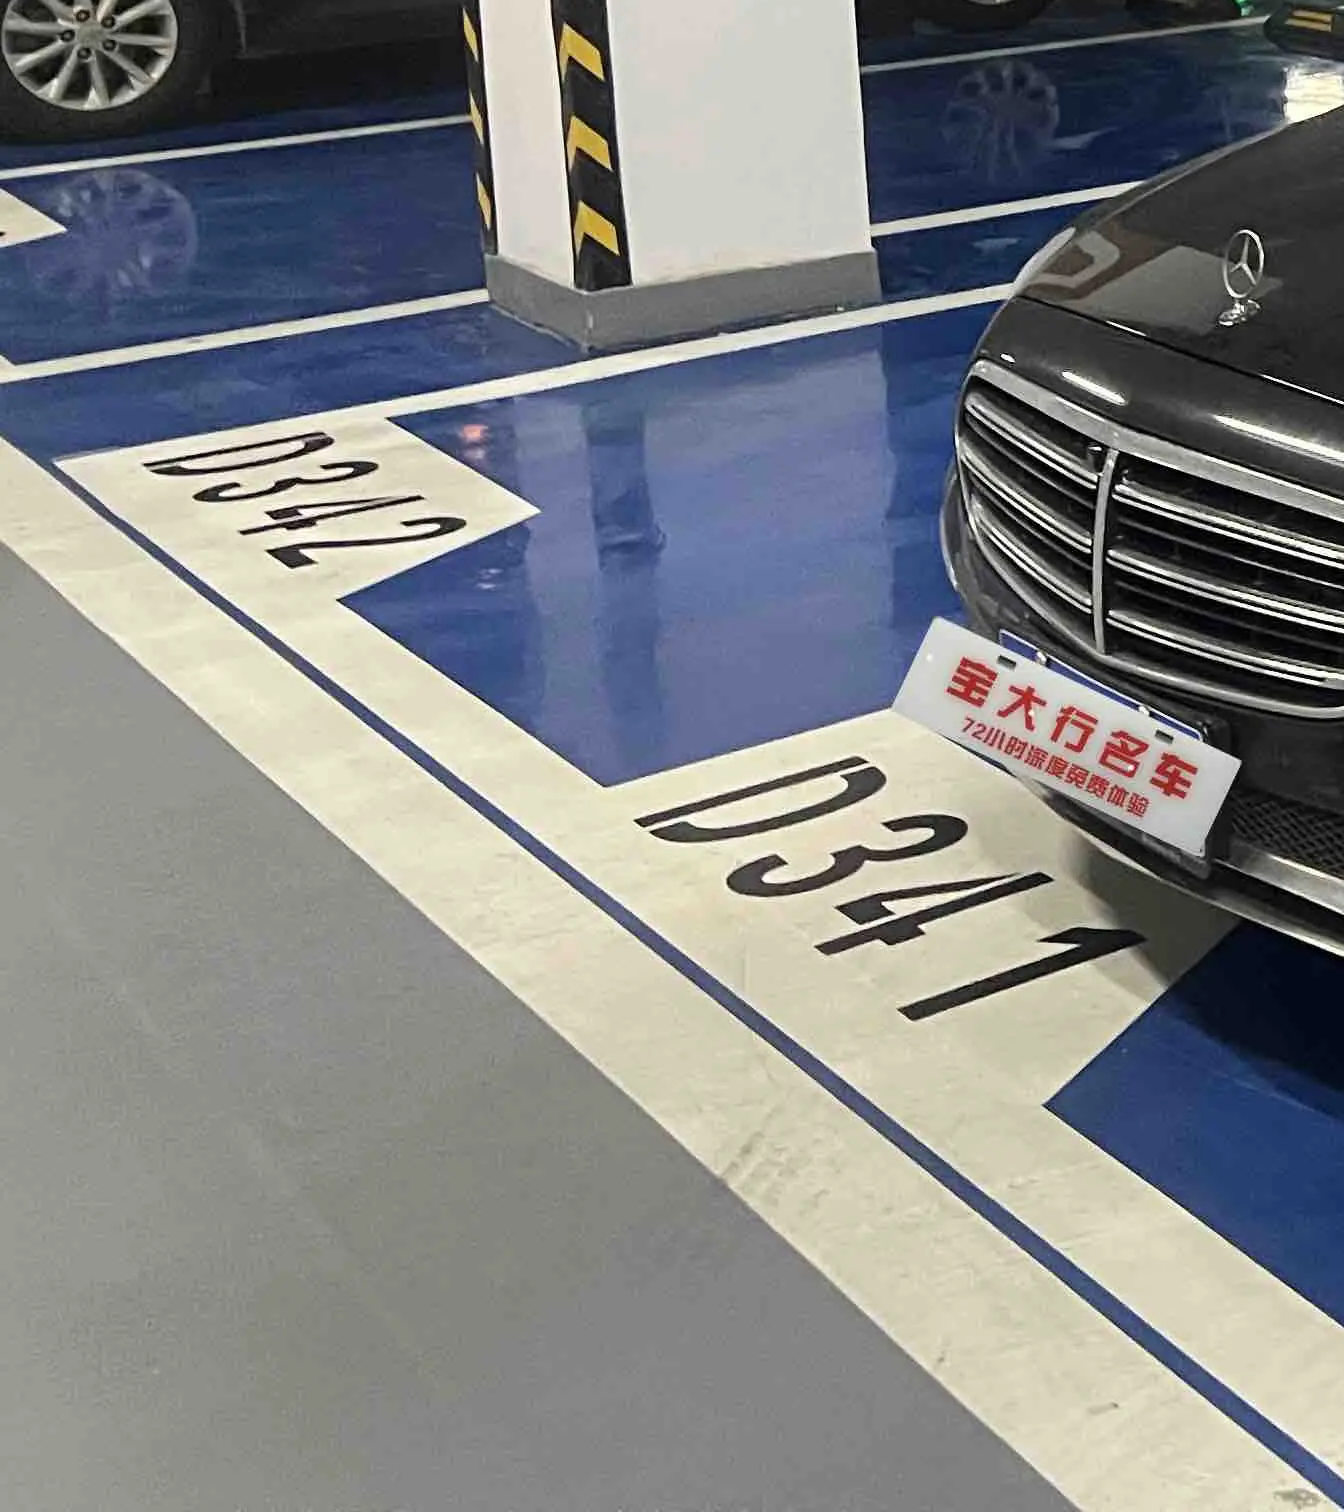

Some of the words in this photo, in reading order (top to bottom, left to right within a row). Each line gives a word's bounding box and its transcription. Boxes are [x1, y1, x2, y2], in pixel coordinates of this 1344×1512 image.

[141, 431, 467, 569] D342
[945, 655, 1199, 801] 宝大行名车
[961, 716, 1150, 819] 72小时深度免费体验
[634, 755, 1148, 1022] D341
